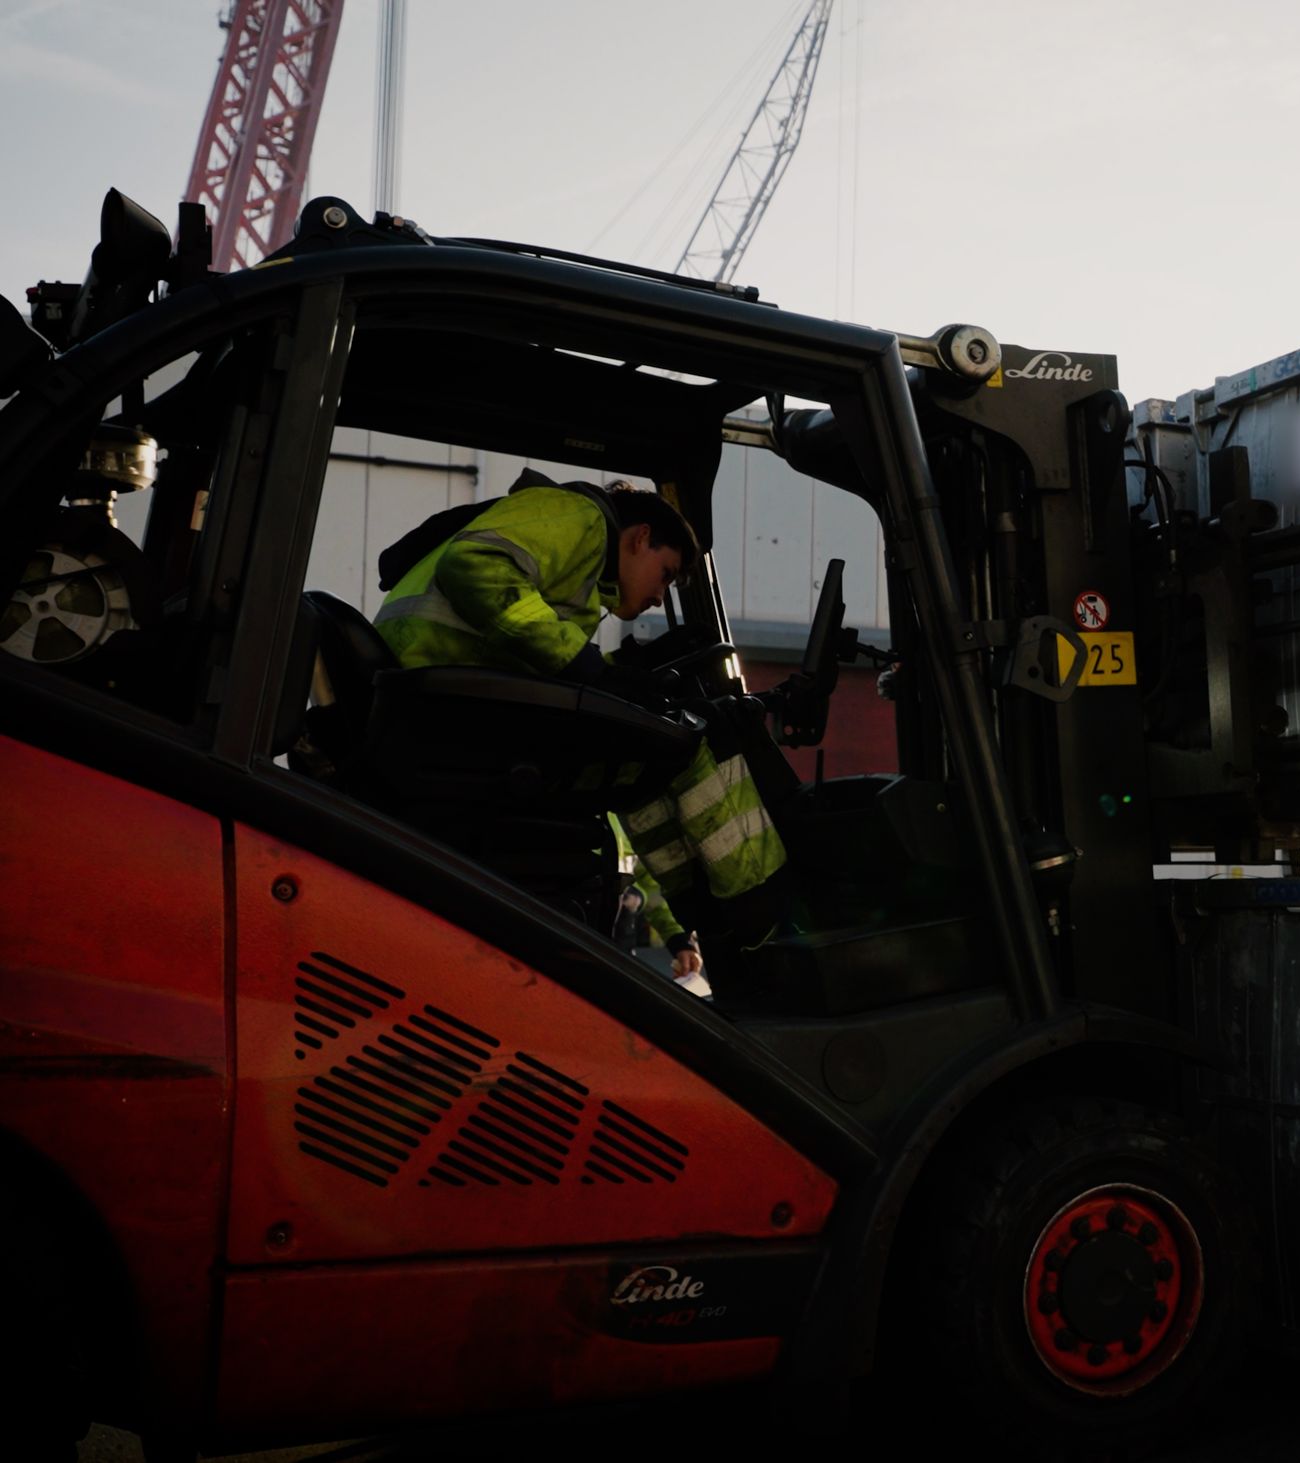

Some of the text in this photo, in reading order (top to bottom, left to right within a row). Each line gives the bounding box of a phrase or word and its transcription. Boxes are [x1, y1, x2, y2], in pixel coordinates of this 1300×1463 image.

[1005, 352, 1093, 382] Linde
[1090, 644, 1124, 674] 25
[609, 1265, 704, 1305] Linde
